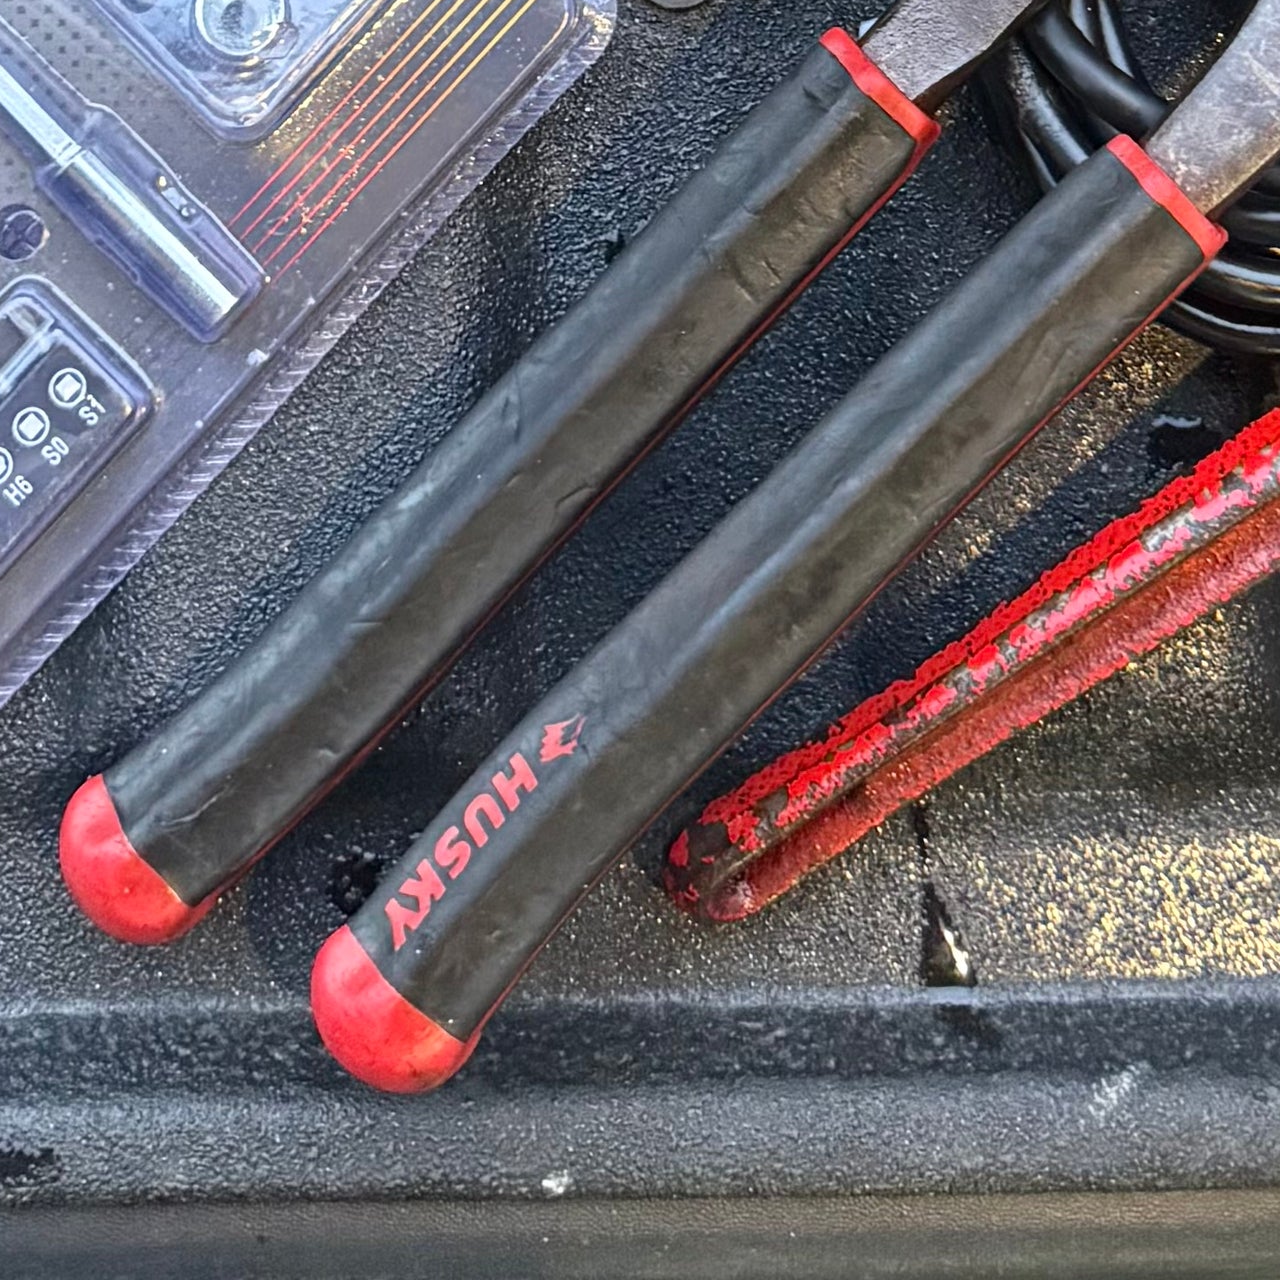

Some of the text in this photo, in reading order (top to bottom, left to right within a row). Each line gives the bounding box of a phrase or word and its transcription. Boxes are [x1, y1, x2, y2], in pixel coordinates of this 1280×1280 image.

[2, 473, 35, 507] H6
[39, 434, 71, 467] S0
[77, 392, 107, 427] S1
[384, 751, 539, 952] HUSKY
